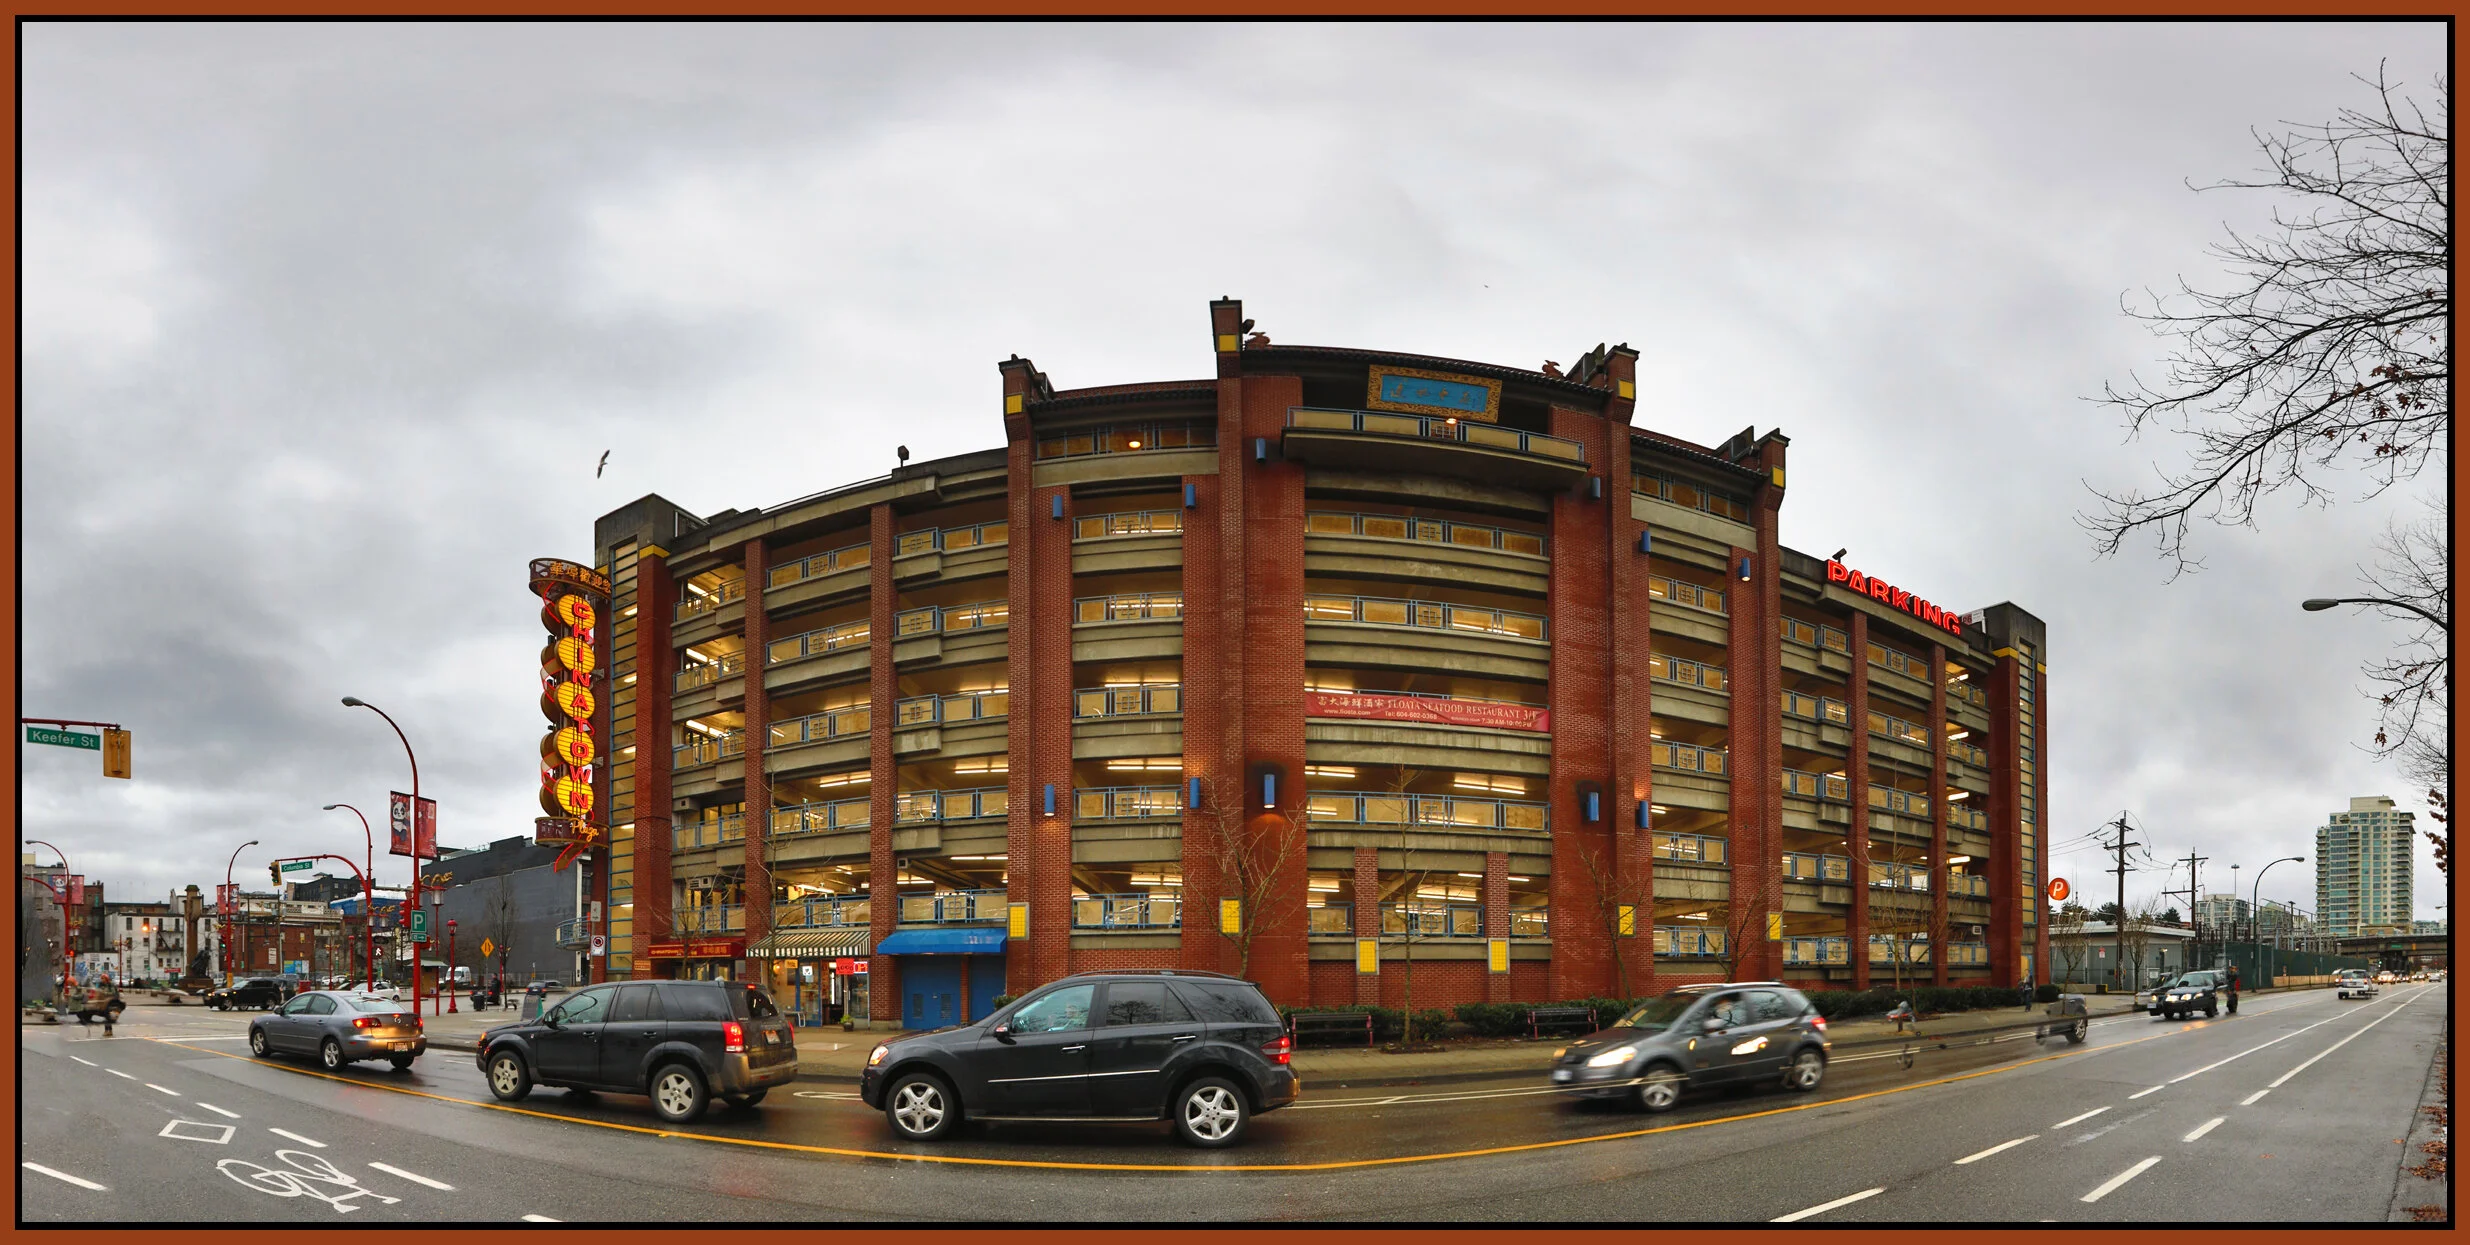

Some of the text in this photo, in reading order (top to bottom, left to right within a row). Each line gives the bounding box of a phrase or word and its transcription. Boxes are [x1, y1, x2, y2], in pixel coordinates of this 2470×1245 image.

[1827, 559, 1961, 635] PARKING
[570, 602, 591, 809] CHINATOWN
[1387, 699, 1420, 710] FLOATA
[1421, 702, 1463, 713] SEAFOOD
[1466, 705, 1521, 719] RESTAURANT
[32, 730, 95, 747] Keefer St
[570, 817, 600, 843] Plaza
[2052, 881, 2064, 897] P
[413, 913, 424, 930] P
